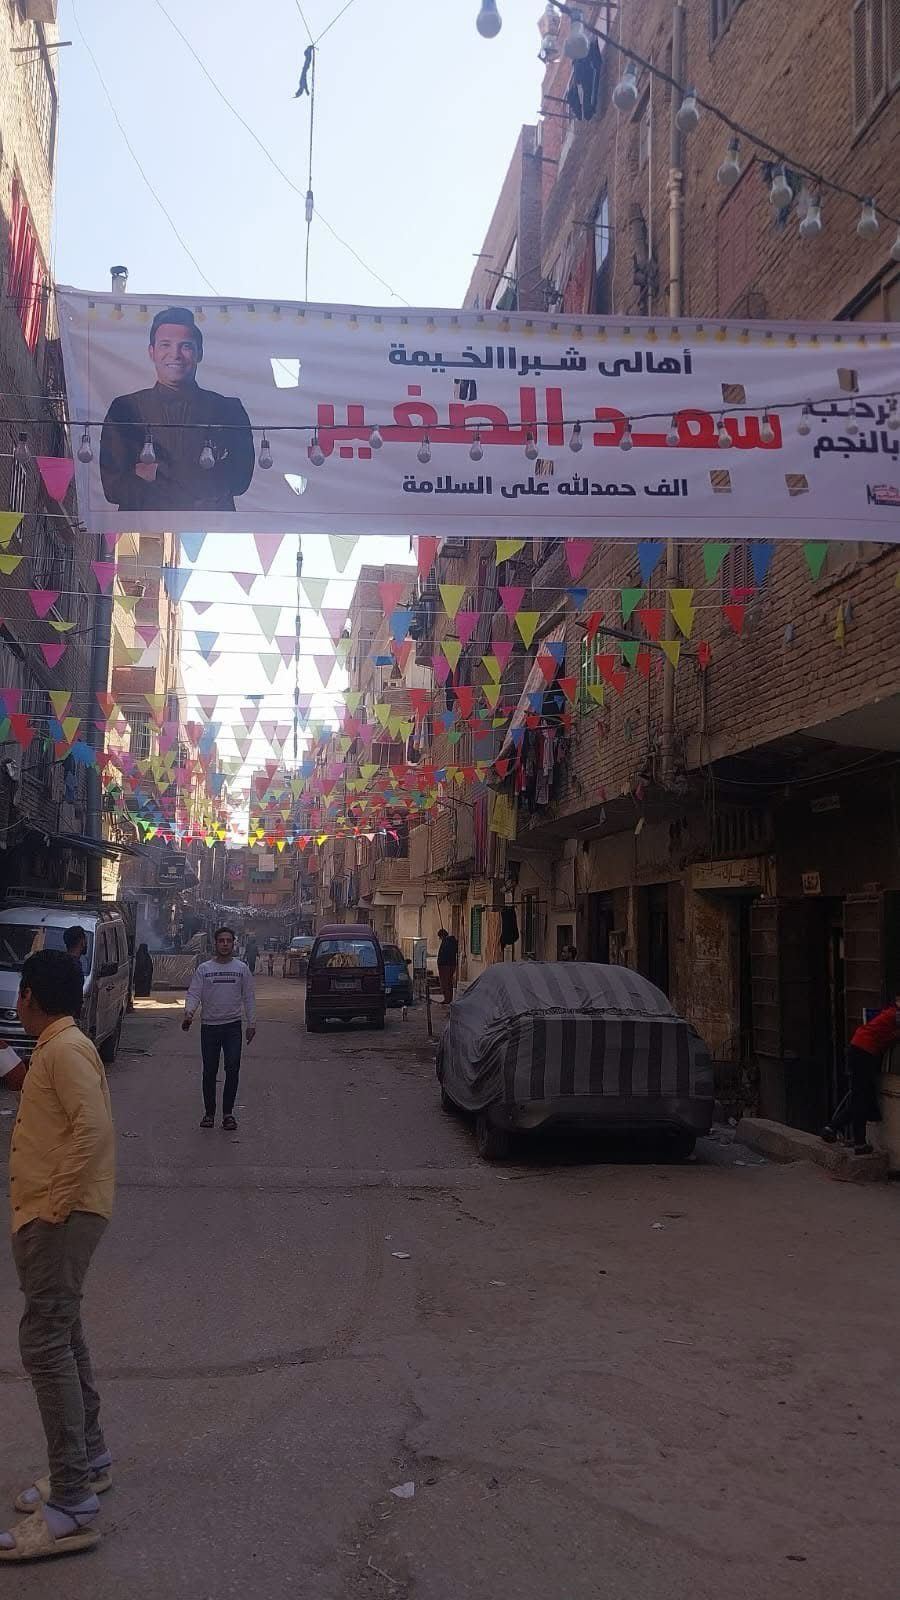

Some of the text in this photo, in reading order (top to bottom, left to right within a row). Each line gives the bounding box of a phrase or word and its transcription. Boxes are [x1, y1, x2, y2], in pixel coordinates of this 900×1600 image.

[598, 348, 692, 377] أهالى
[308, 385, 782, 459] سعد الصغير
[813, 430, 899, 461] بالنجم
[402, 475, 492, 495] السلامة
[500, 476, 550, 499] على
[644, 478, 688, 496] الف
